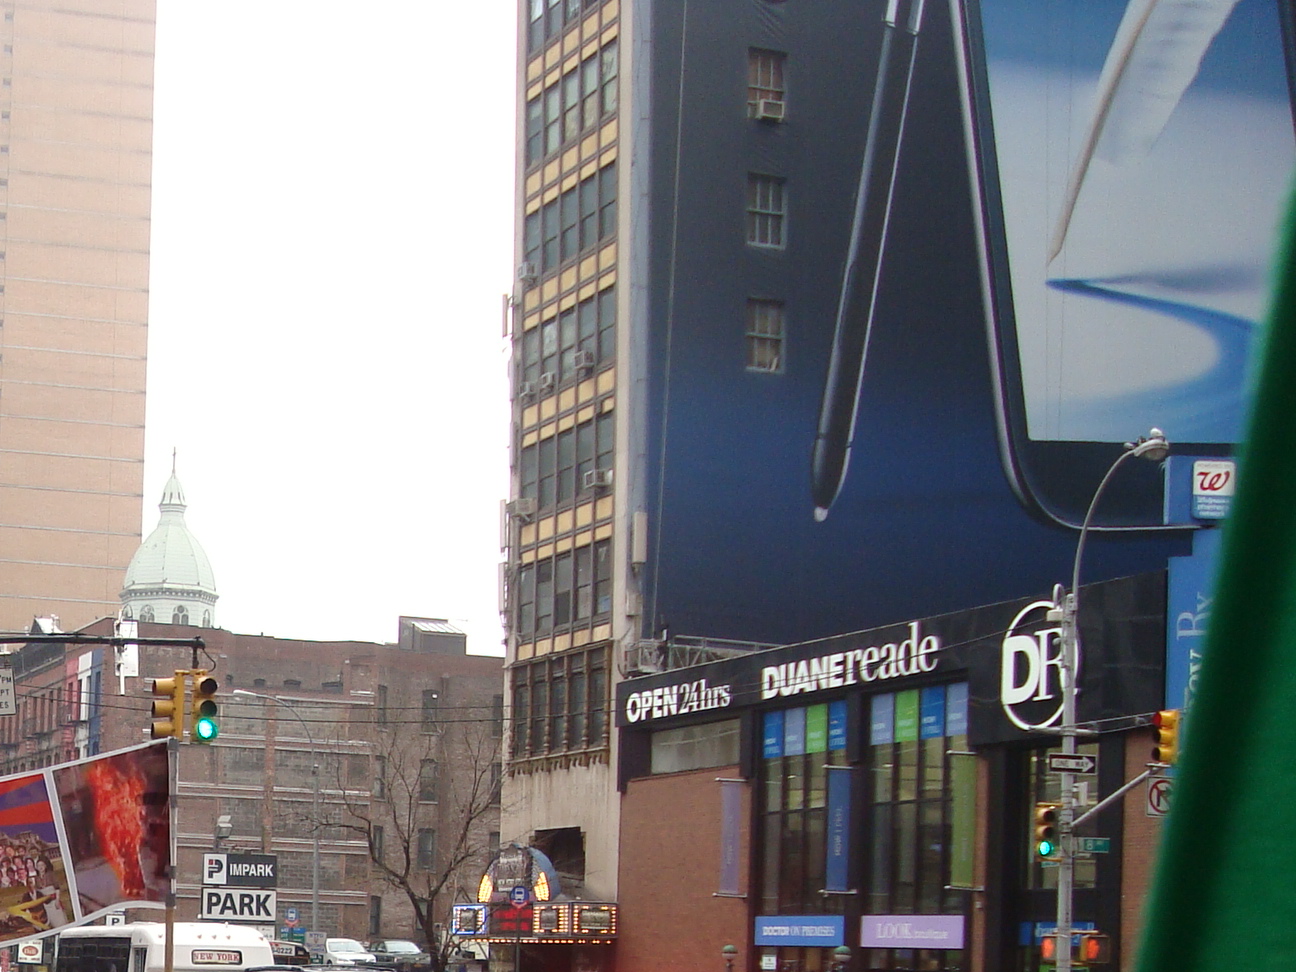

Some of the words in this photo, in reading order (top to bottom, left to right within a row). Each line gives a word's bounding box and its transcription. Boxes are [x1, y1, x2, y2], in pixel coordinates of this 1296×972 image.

[626, 685, 679, 723] OPEN
[229, 863, 274, 877] IMPARK
[207, 892, 272, 917] PARK
[111, 917, 120, 926] P
[193, 952, 214, 961] NEW
[216, 952, 240, 962] YORK
